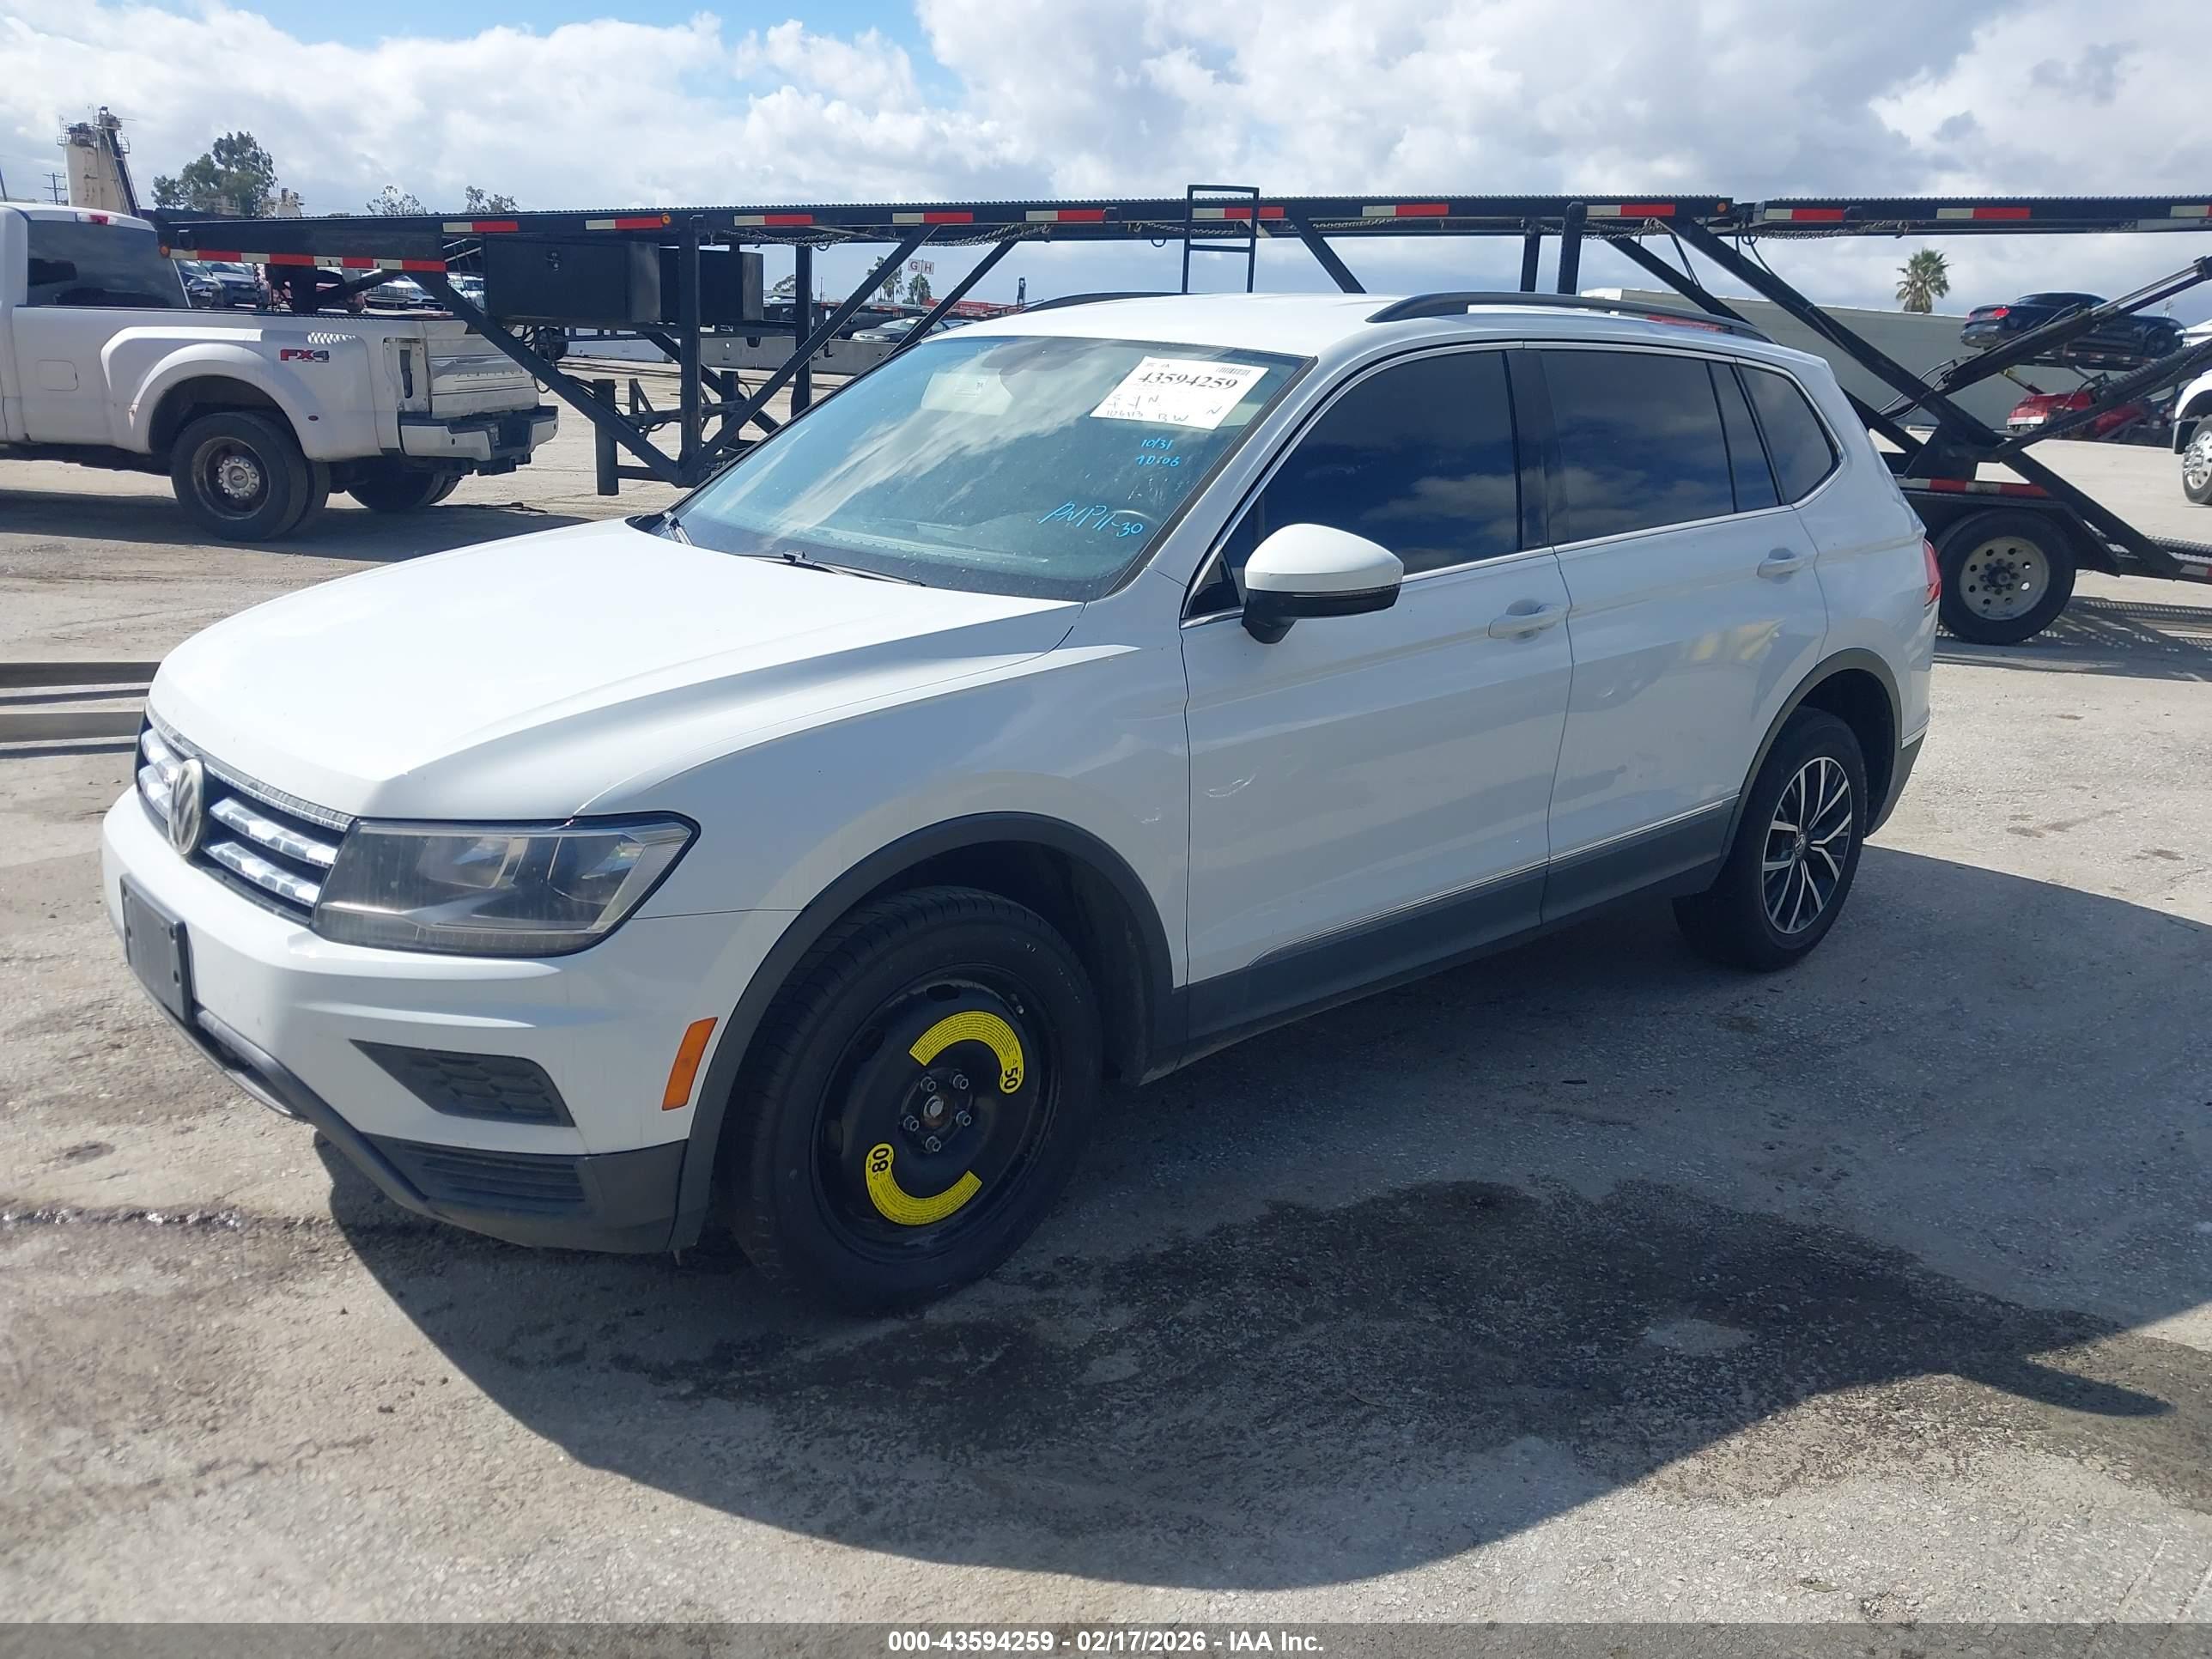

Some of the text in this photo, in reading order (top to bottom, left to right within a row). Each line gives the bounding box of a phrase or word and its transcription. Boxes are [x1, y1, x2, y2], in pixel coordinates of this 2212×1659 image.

[910, 260, 933, 273] G H
[280, 349, 330, 362] FX4
[1138, 371, 1238, 390] 43594259
[1140, 437, 1175, 450] 10/31
[1135, 454, 1181, 467] 10:06
[1004, 1066, 1018, 1090] 50
[872, 1147, 890, 1173] 80
